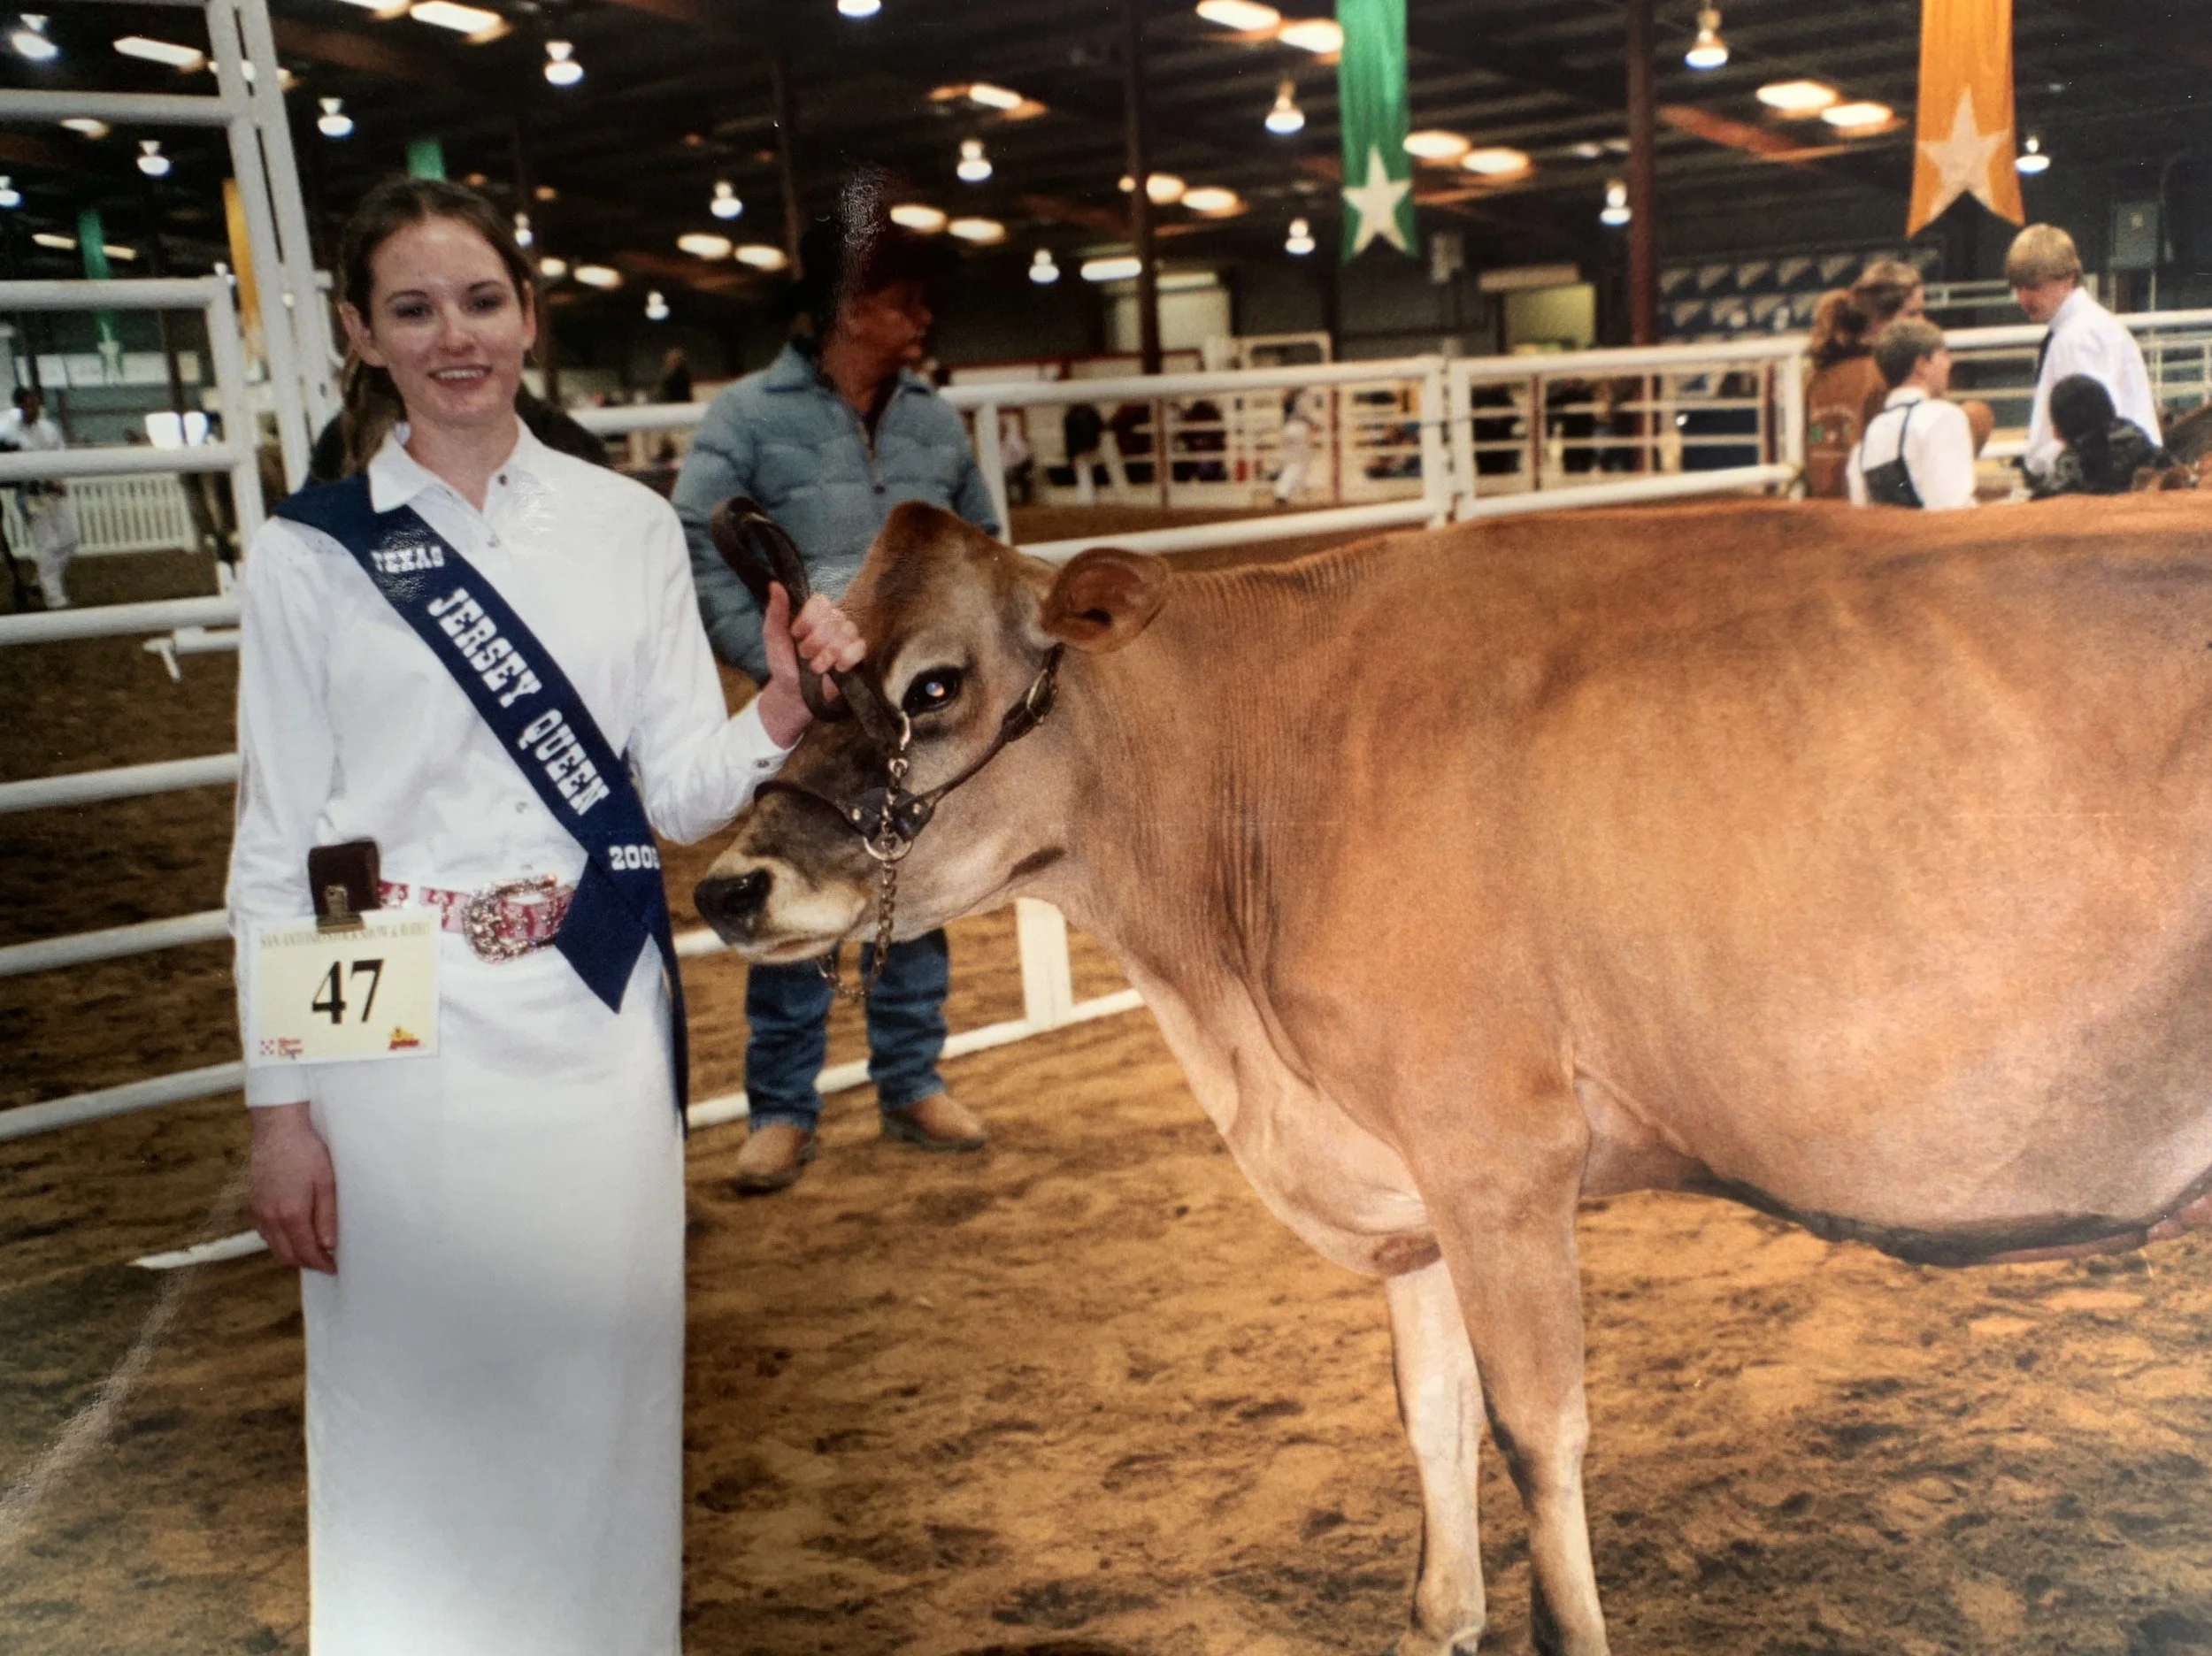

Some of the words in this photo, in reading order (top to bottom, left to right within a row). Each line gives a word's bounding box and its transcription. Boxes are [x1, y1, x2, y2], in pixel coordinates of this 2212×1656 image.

[370, 545, 445, 574] TEXAS
[427, 586, 542, 709] JERSEY
[517, 708, 611, 816] QUEEN
[311, 958, 386, 1025] 47
